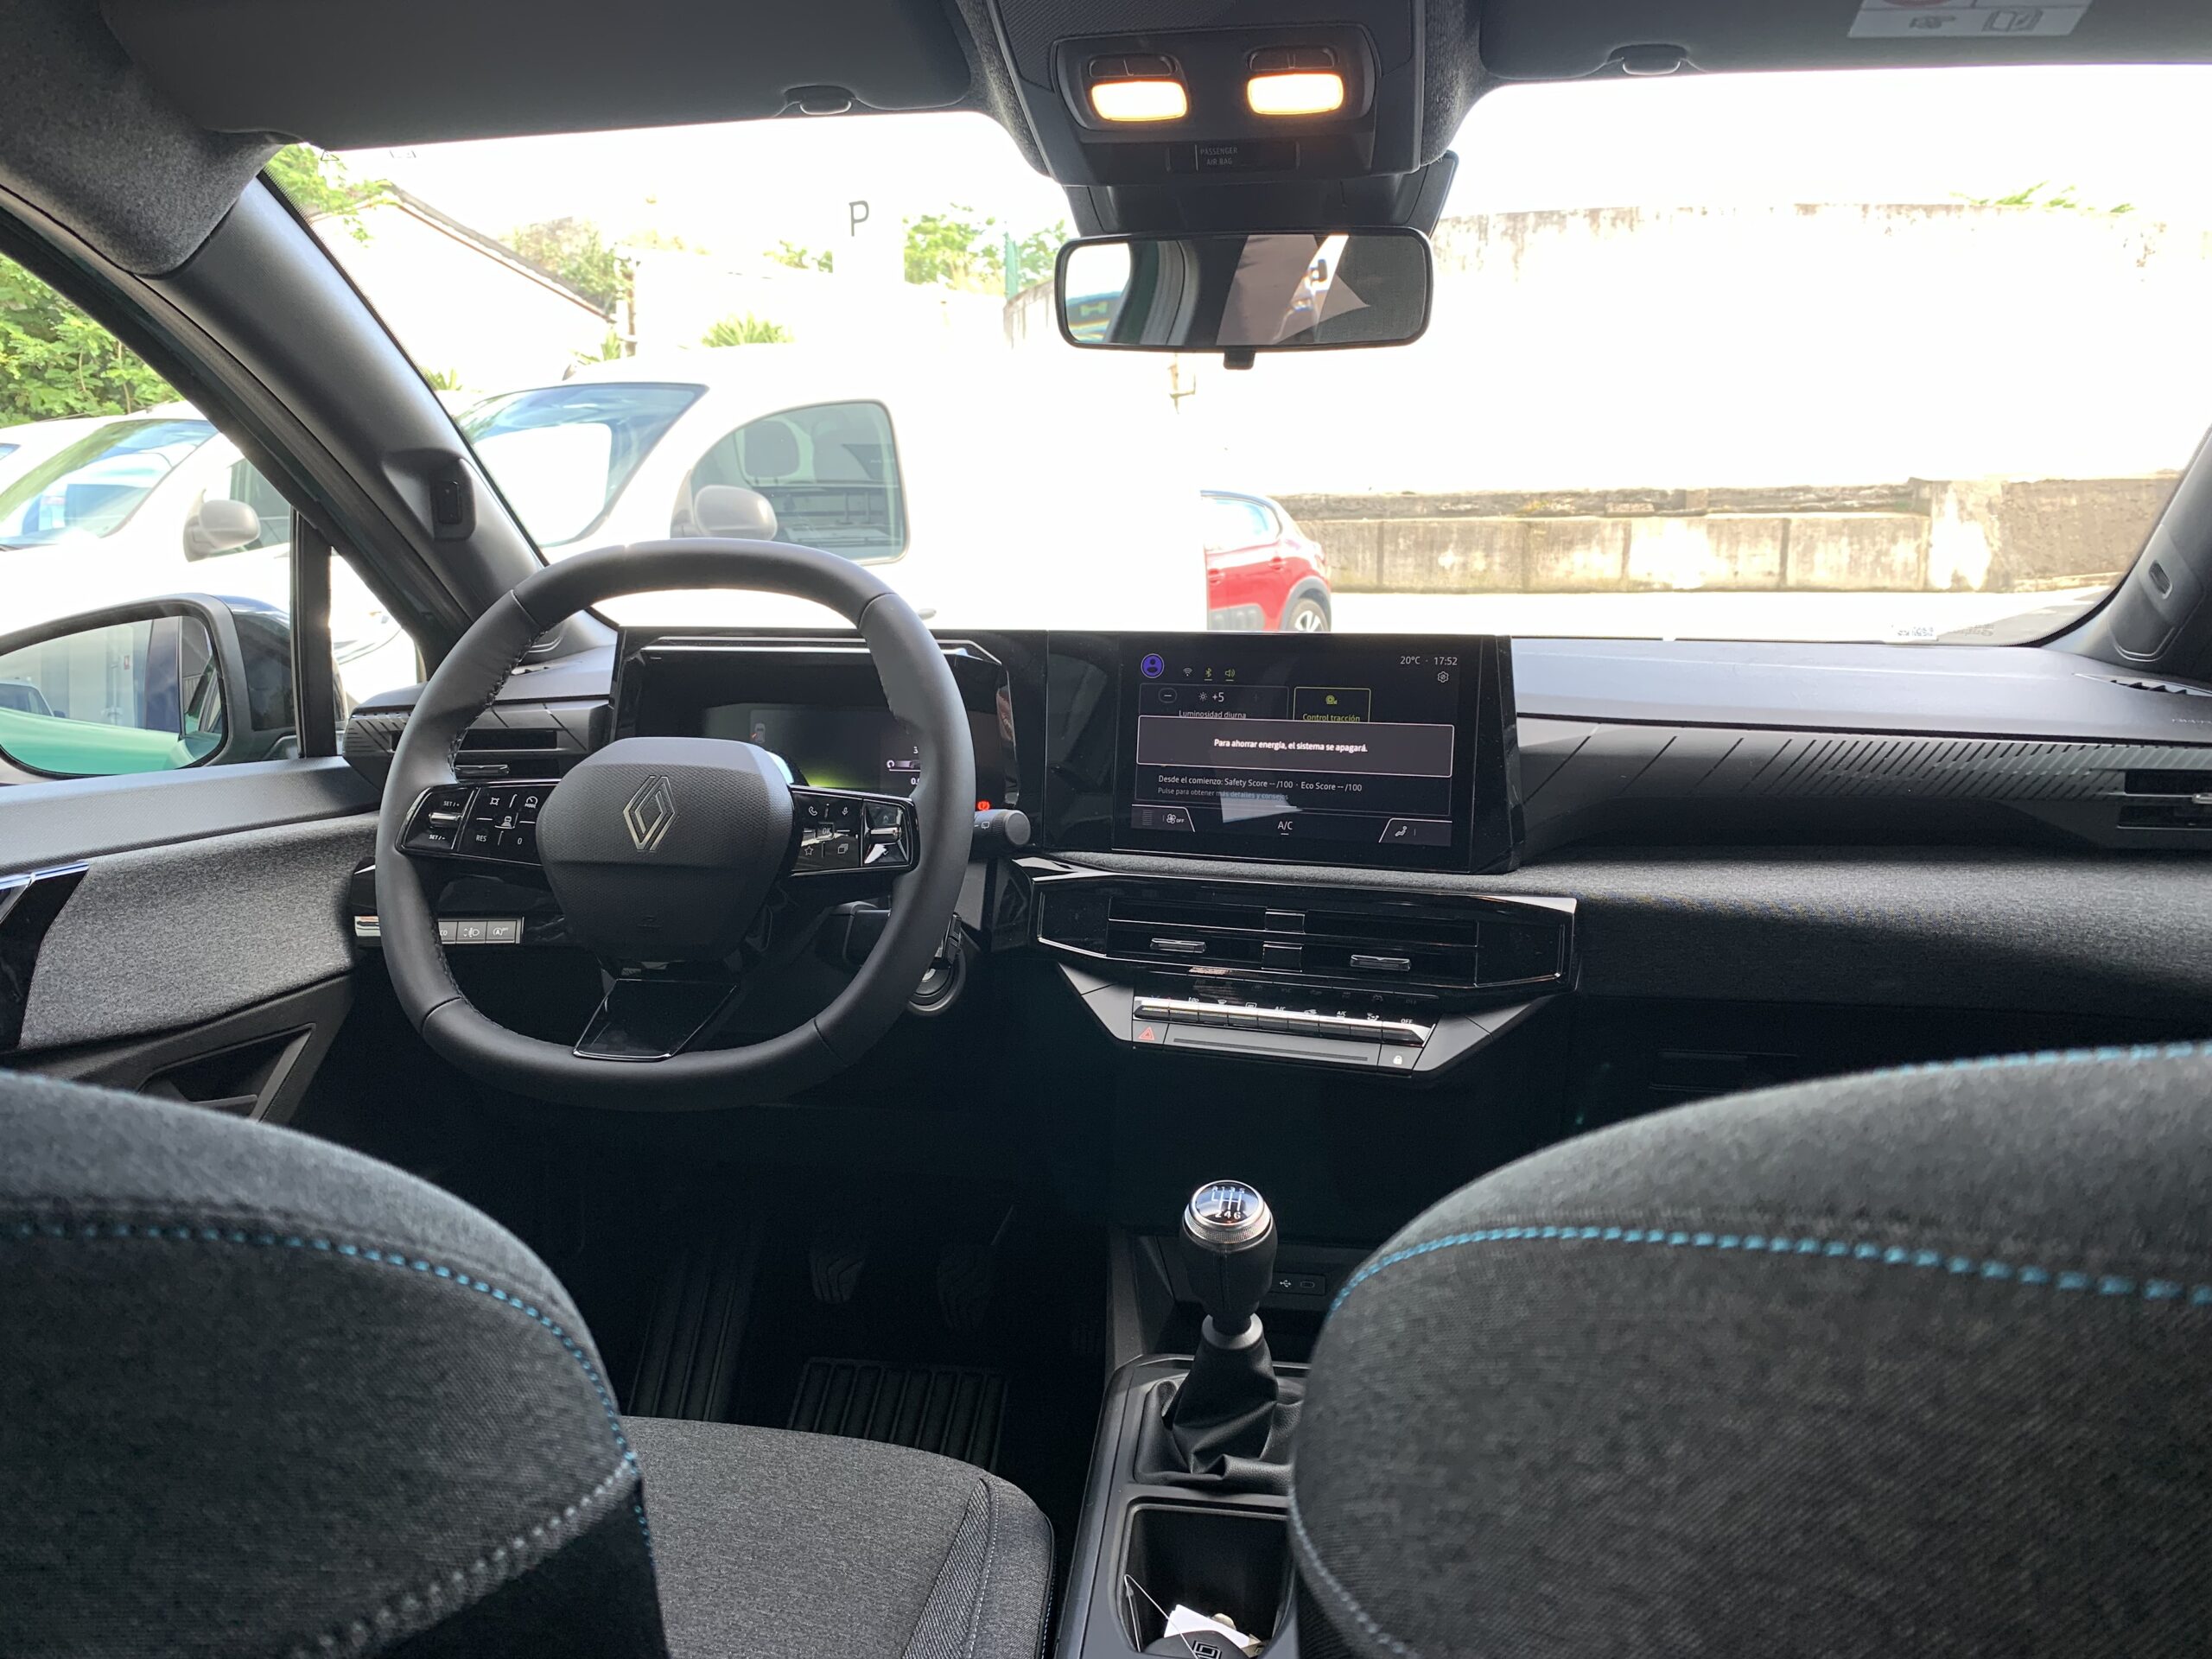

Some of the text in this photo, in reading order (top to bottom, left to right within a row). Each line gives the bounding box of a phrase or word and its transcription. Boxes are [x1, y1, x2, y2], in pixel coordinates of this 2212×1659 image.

[1200, 147, 1238, 156] PASSENGER
[849, 200, 869, 237] P
[1400, 656, 1458, 666] 20°C 17:52
[1179, 709, 1223, 718] Luminosidad
[1214, 739, 1230, 747] Para
[1231, 740, 1257, 748] ahorrar
[1288, 741, 1296, 750] el
[1297, 742, 1325, 752] sistema
[1335, 743, 1368, 754] apagará.
[1188, 777, 1223, 785] comienzo:
[1224, 779, 1247, 788] Safety
[1300, 781, 1313, 790] Eco
[1315, 782, 1336, 791] Score
[1277, 821, 1294, 830] A/C
[1224, 1210, 1231, 1219] 4
[1233, 1211, 1241, 1220] 6
